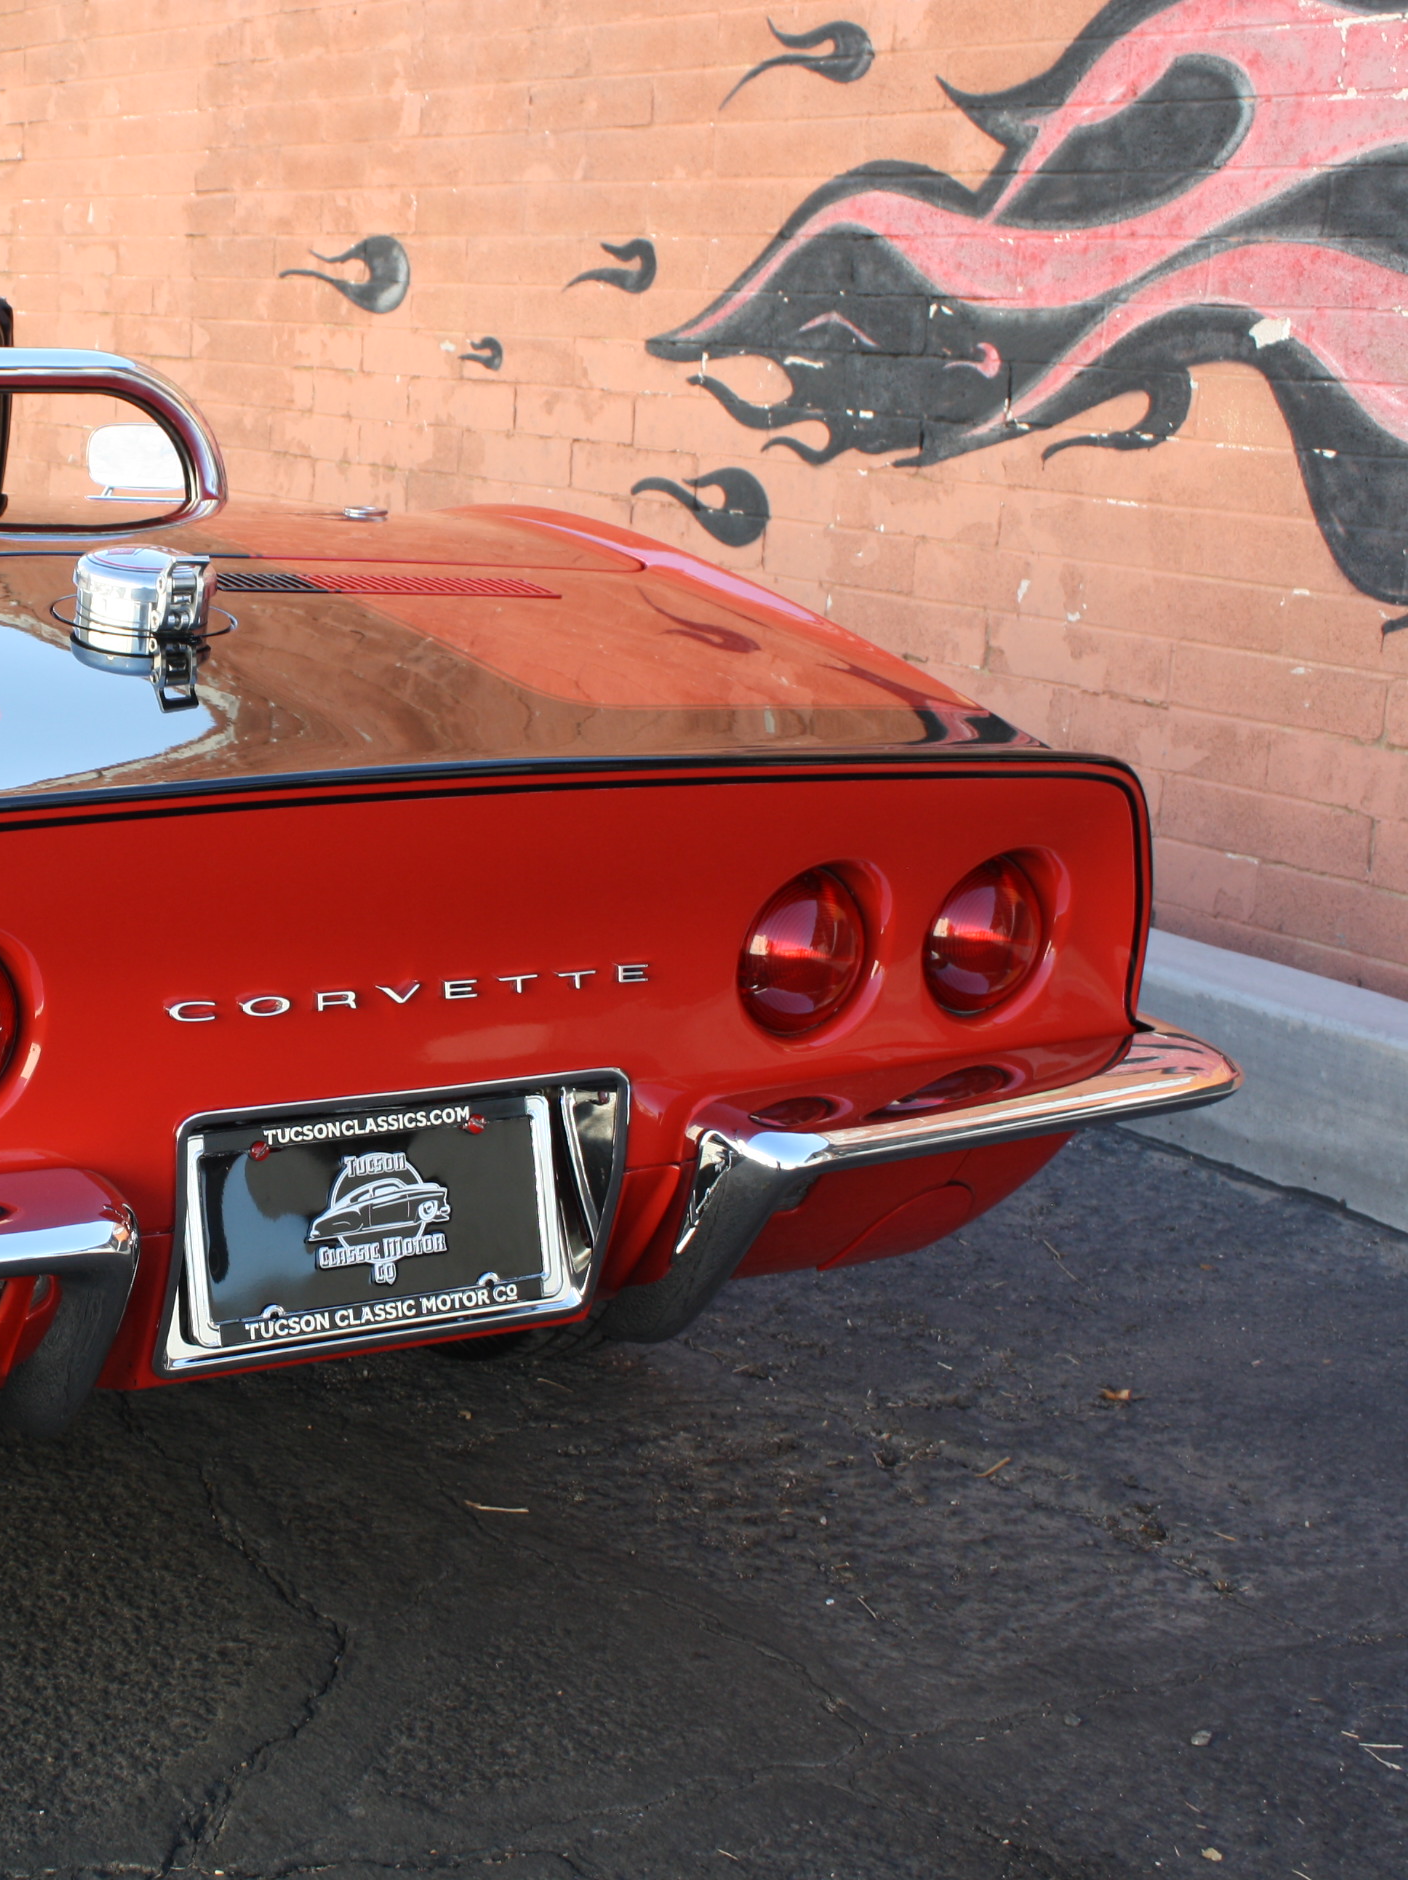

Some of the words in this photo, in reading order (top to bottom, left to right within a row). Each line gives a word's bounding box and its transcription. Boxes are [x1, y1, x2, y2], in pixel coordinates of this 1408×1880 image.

[165, 963, 649, 1022] CORVETTE
[263, 1105, 470, 1146] TUCSONCLASSICS.COM
[245, 1313, 330, 1341] TUCSON
[334, 1299, 417, 1327] CLASSIC
[419, 1288, 491, 1315] MOTOR
